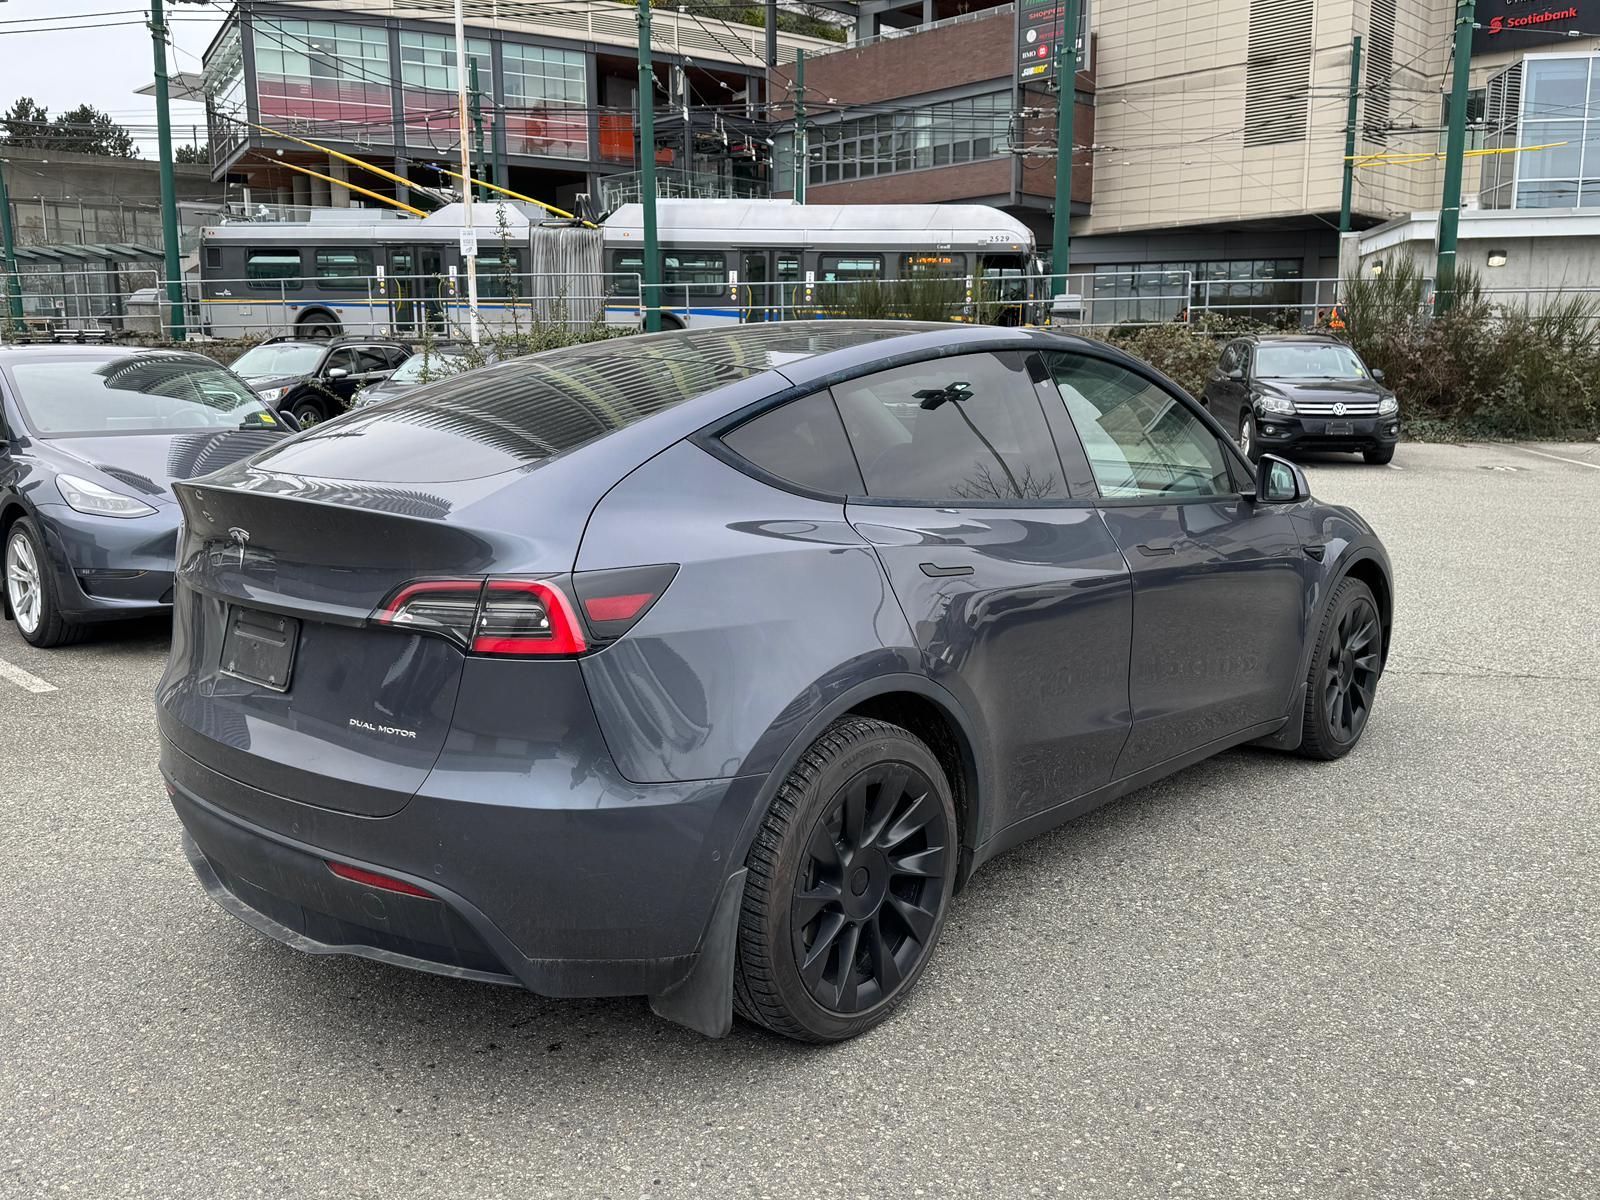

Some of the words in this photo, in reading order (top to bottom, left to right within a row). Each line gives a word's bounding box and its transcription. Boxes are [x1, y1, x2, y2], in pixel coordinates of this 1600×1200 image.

[1507, 7, 1577, 28] Scotiabank
[1022, 51, 1036, 59] BMO
[1021, 64, 1048, 77] SUBWAY
[349, 718, 376, 731] DUAL
[378, 725, 417, 739] MOTOR
